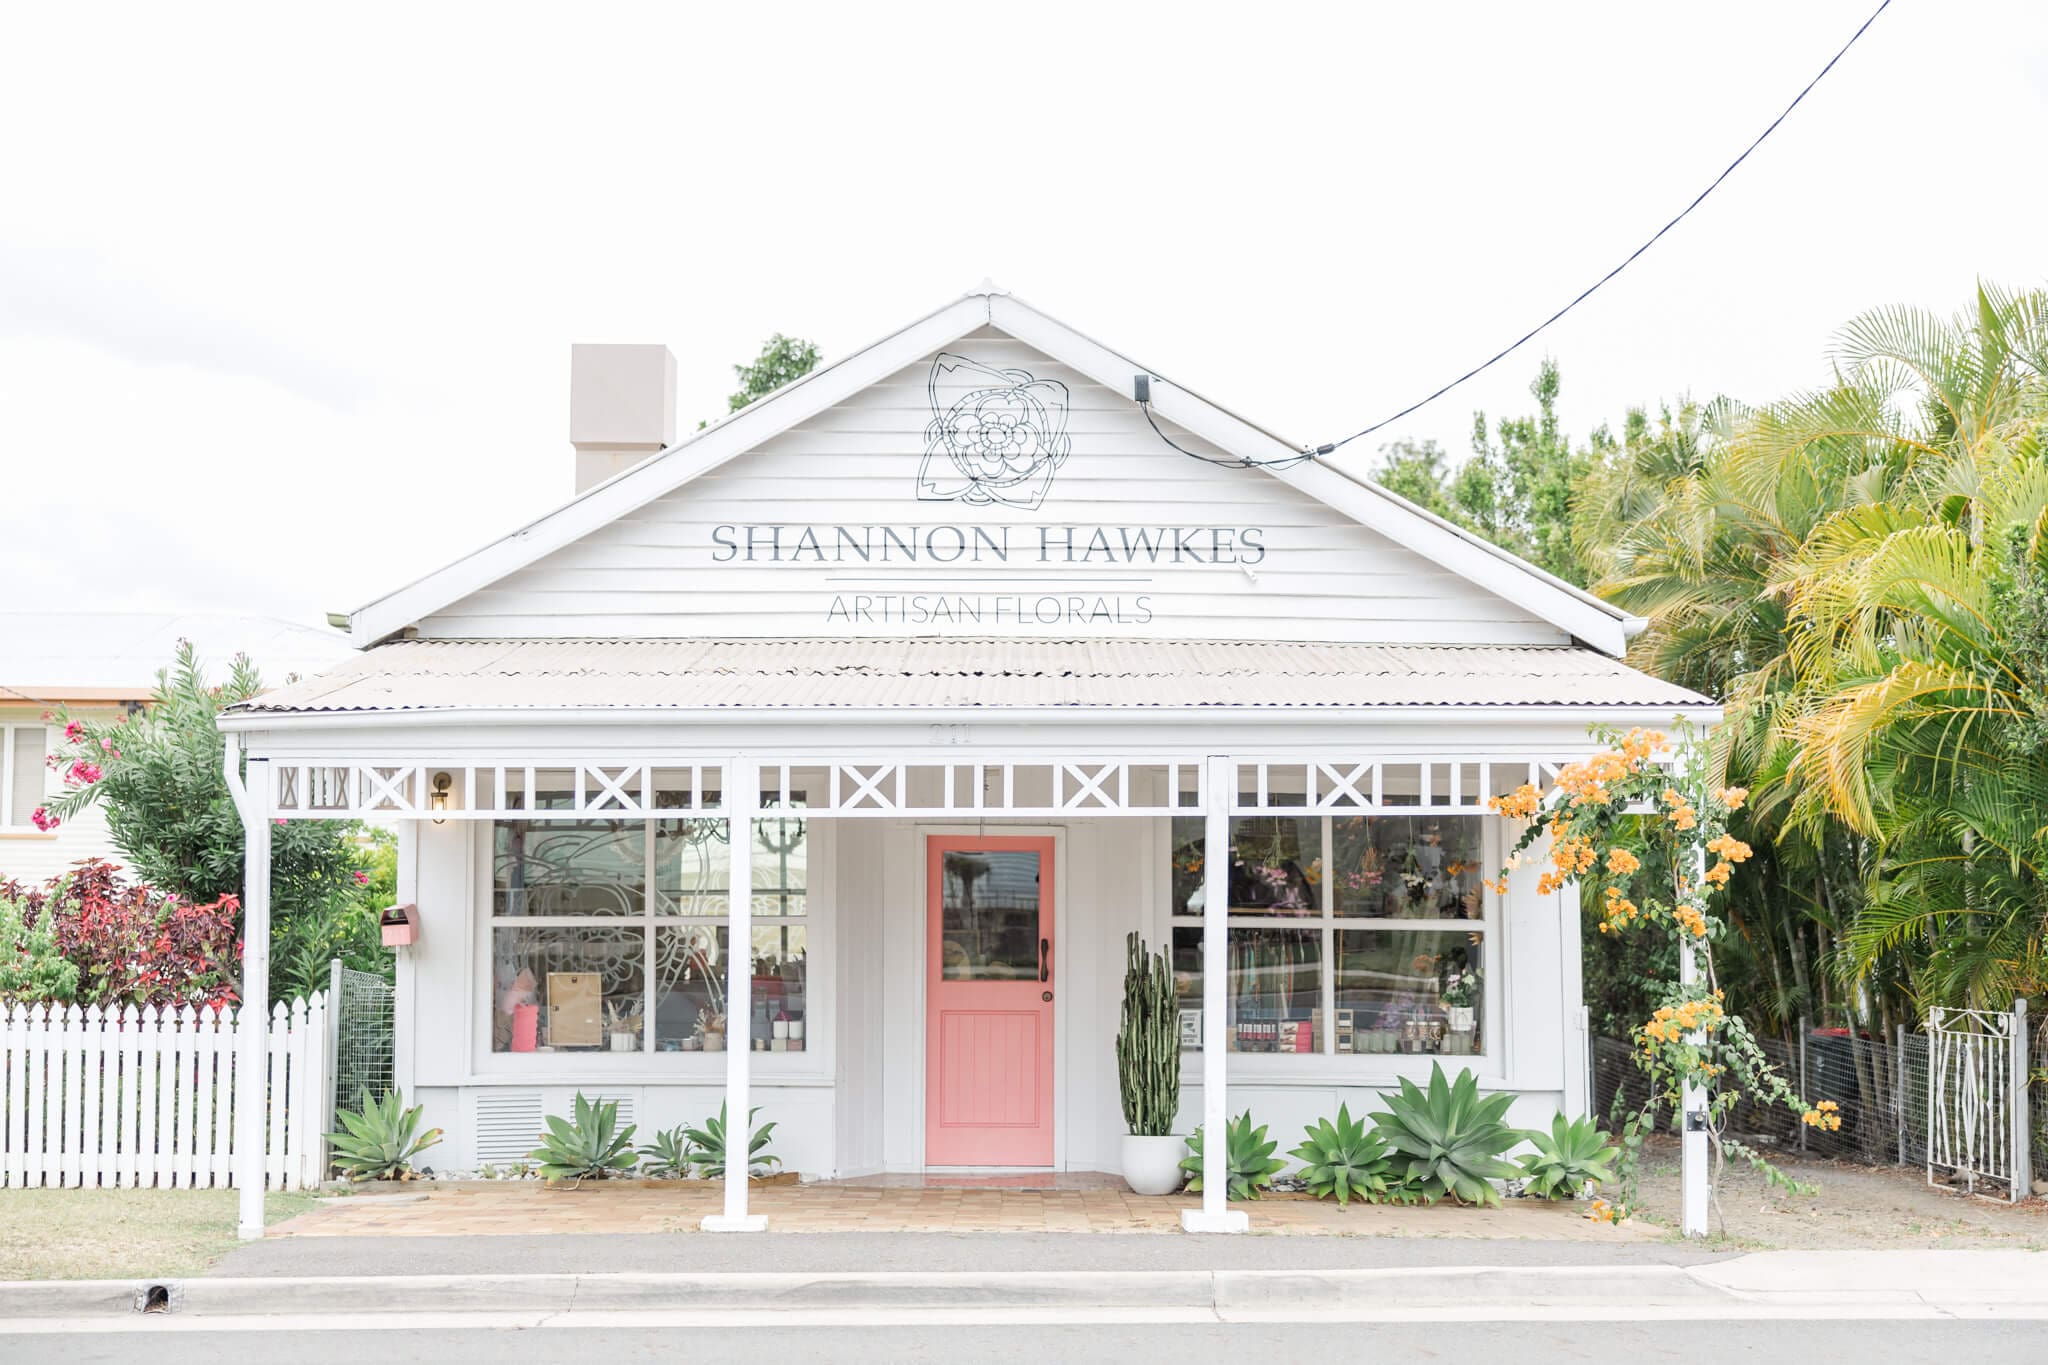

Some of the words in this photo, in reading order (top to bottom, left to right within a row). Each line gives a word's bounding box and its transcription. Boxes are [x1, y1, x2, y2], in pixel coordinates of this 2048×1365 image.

[712, 525, 1011, 562] SHANNON
[1036, 526, 1266, 564] HAWKES
[826, 595, 980, 624] ARTISAN
[996, 596, 1153, 625] FLORALS
